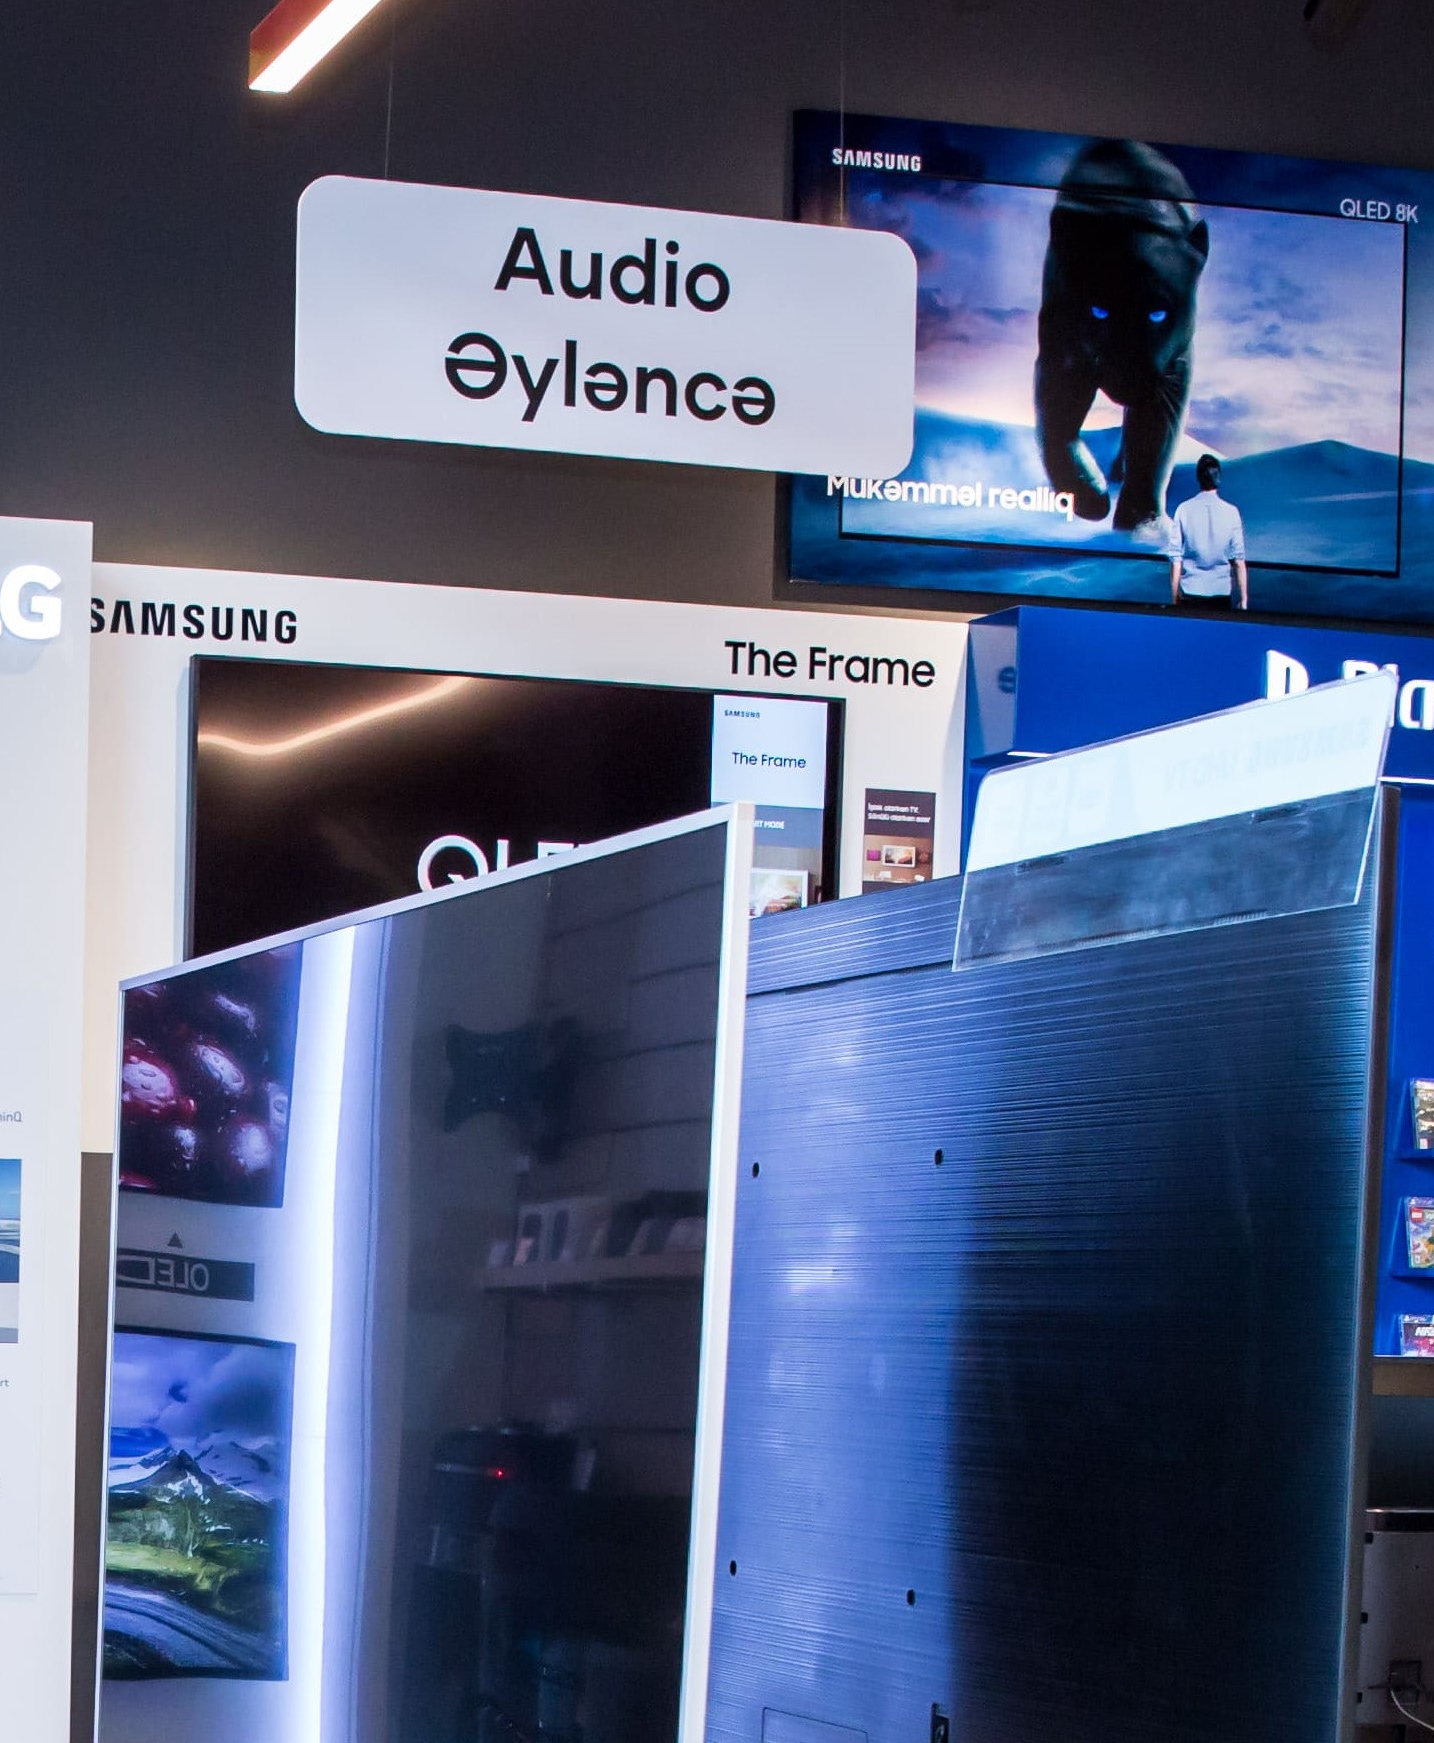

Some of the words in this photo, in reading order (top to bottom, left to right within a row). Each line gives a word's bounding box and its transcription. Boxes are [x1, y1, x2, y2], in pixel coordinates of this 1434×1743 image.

[832, 148, 922, 172] SAMSUNG
[1340, 198, 1391, 222] QLED
[1395, 203, 1419, 223] 8K
[494, 226, 730, 312] Audio
[445, 331, 776, 425] Əyləncə
[91, 597, 297, 645] SAMSUNG
[724, 640, 797, 678] The
[809, 646, 936, 688] Frame
[724, 709, 761, 719] SAMSUNG
[732, 752, 758, 766] The
[761, 754, 807, 769] Frame
